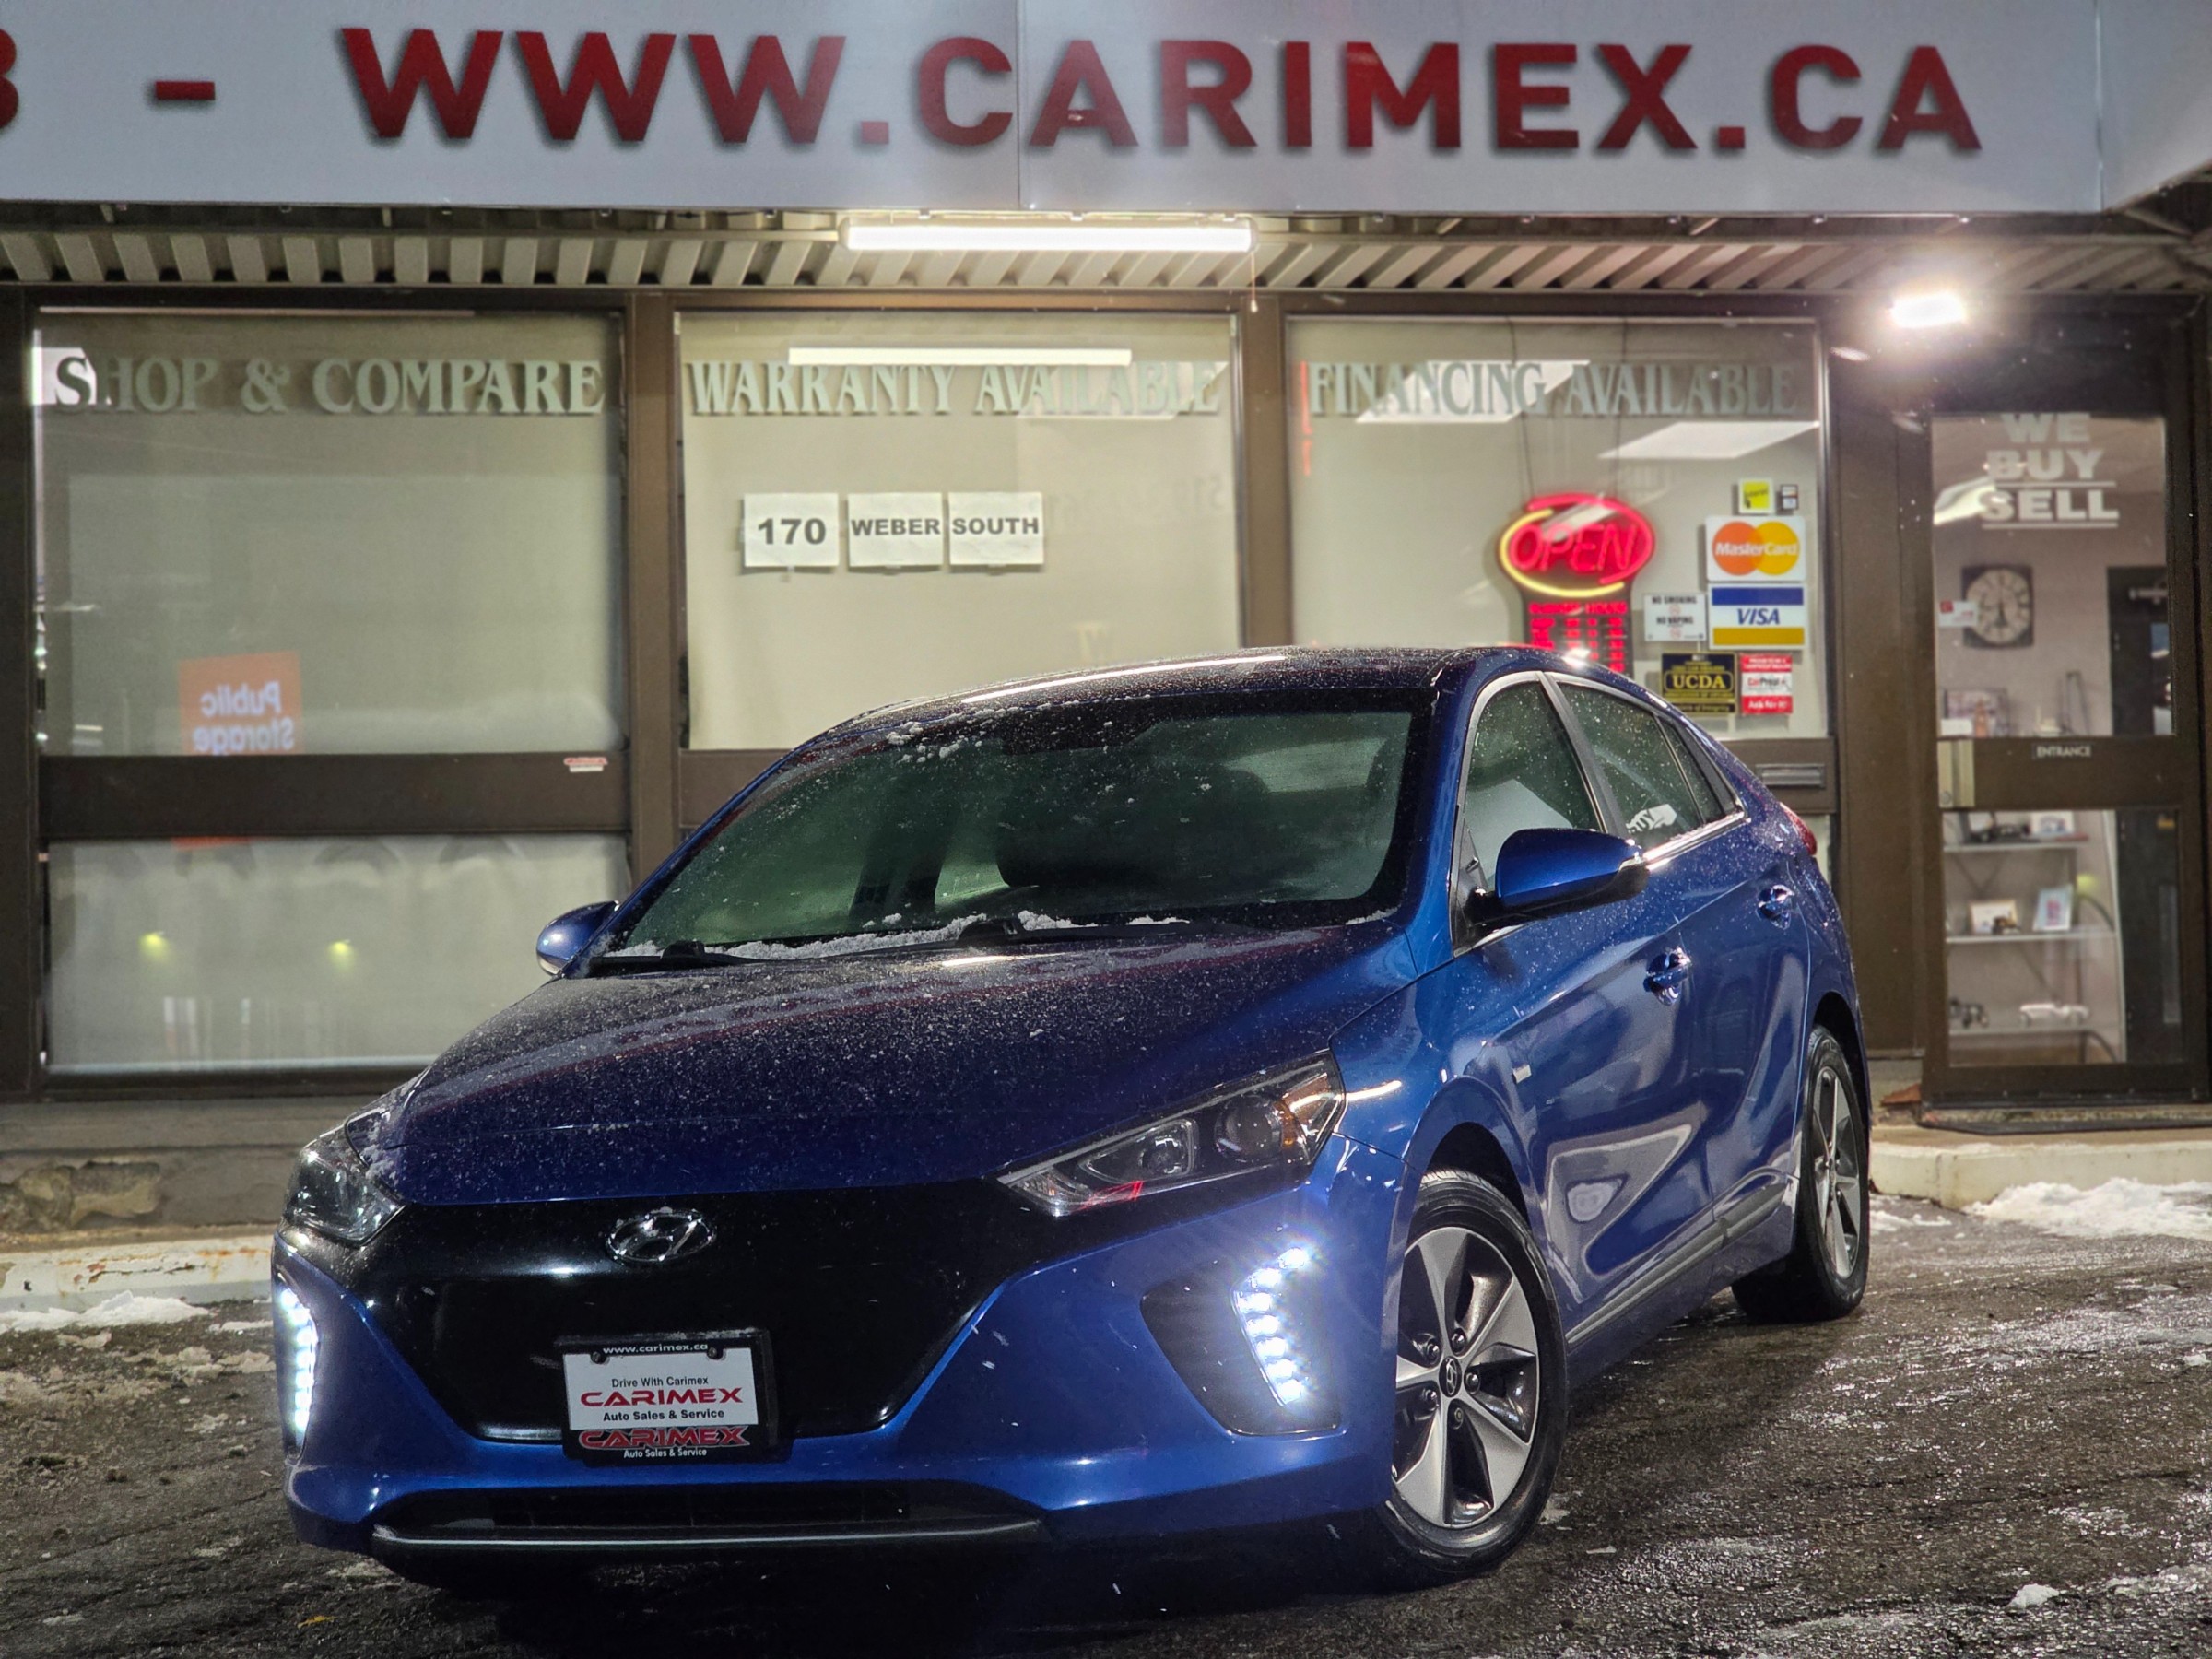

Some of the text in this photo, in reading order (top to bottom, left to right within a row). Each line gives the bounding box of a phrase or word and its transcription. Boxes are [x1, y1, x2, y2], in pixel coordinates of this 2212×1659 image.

[341, 27, 1982, 152] WWW.CARIMEX.CA
[53, 356, 606, 416] SHOP & COMPARE
[688, 360, 1222, 416] WARRANTY AVAILABLE
[1309, 359, 1797, 417] FINANCING AVAILABLE
[2000, 412, 2091, 443] WE
[1986, 449, 2104, 480] BUY
[1982, 489, 2119, 521] SELL
[757, 517, 1040, 546] 170 WEBER SOUTH
[1509, 524, 1637, 572] OPEN
[1715, 541, 1799, 557] MasterCard
[1737, 607, 1781, 626] VISA
[1673, 675, 1726, 688] UCDA
[2036, 745, 2092, 758] ENTRANCE
[603, 1343, 709, 1355] www.carimex.ca
[611, 1376, 709, 1388] Drive With Carimex
[581, 1387, 743, 1407] CARIMEX
[603, 1408, 725, 1422] Auto Sales & Service
[580, 1426, 748, 1448] CARIMEX
[623, 1447, 708, 1459] Auto Sales & Service
